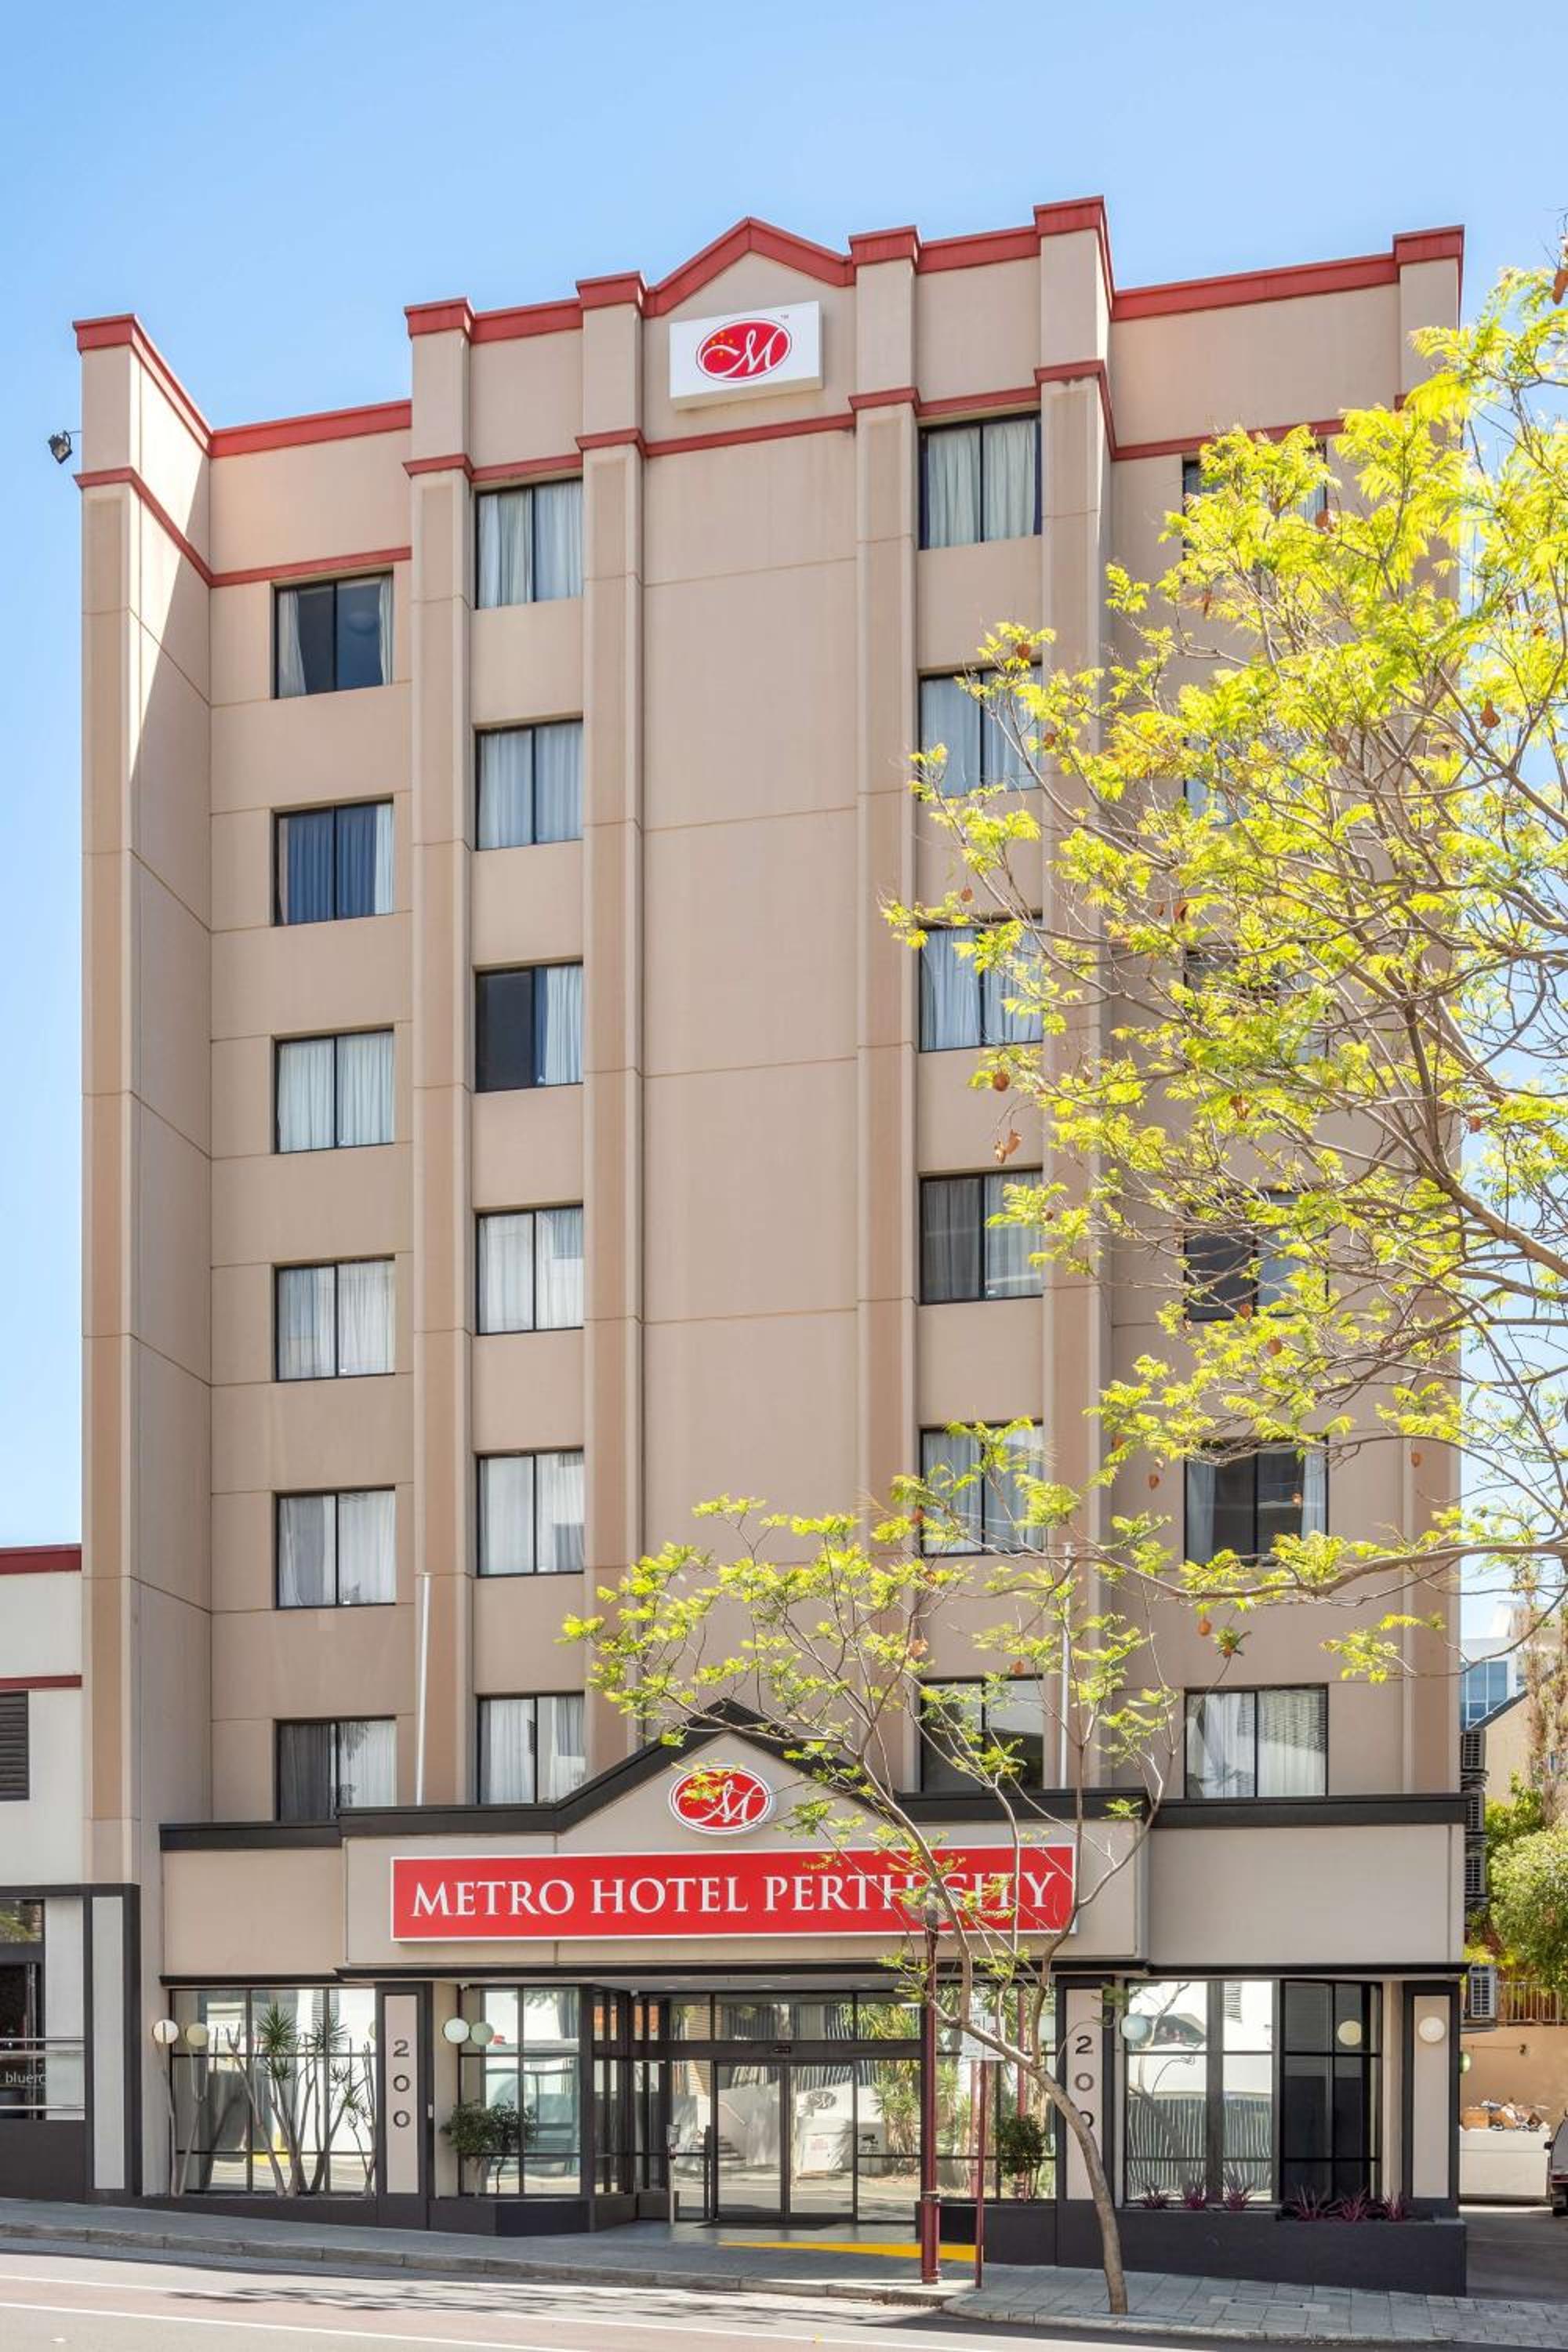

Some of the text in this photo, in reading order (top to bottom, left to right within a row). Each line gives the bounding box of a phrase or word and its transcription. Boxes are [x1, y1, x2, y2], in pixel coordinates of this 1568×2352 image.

[410, 1879, 575, 1918] METRO
[590, 1877, 748, 1914] HOTEL
[393, 2039, 410, 2128] 200
